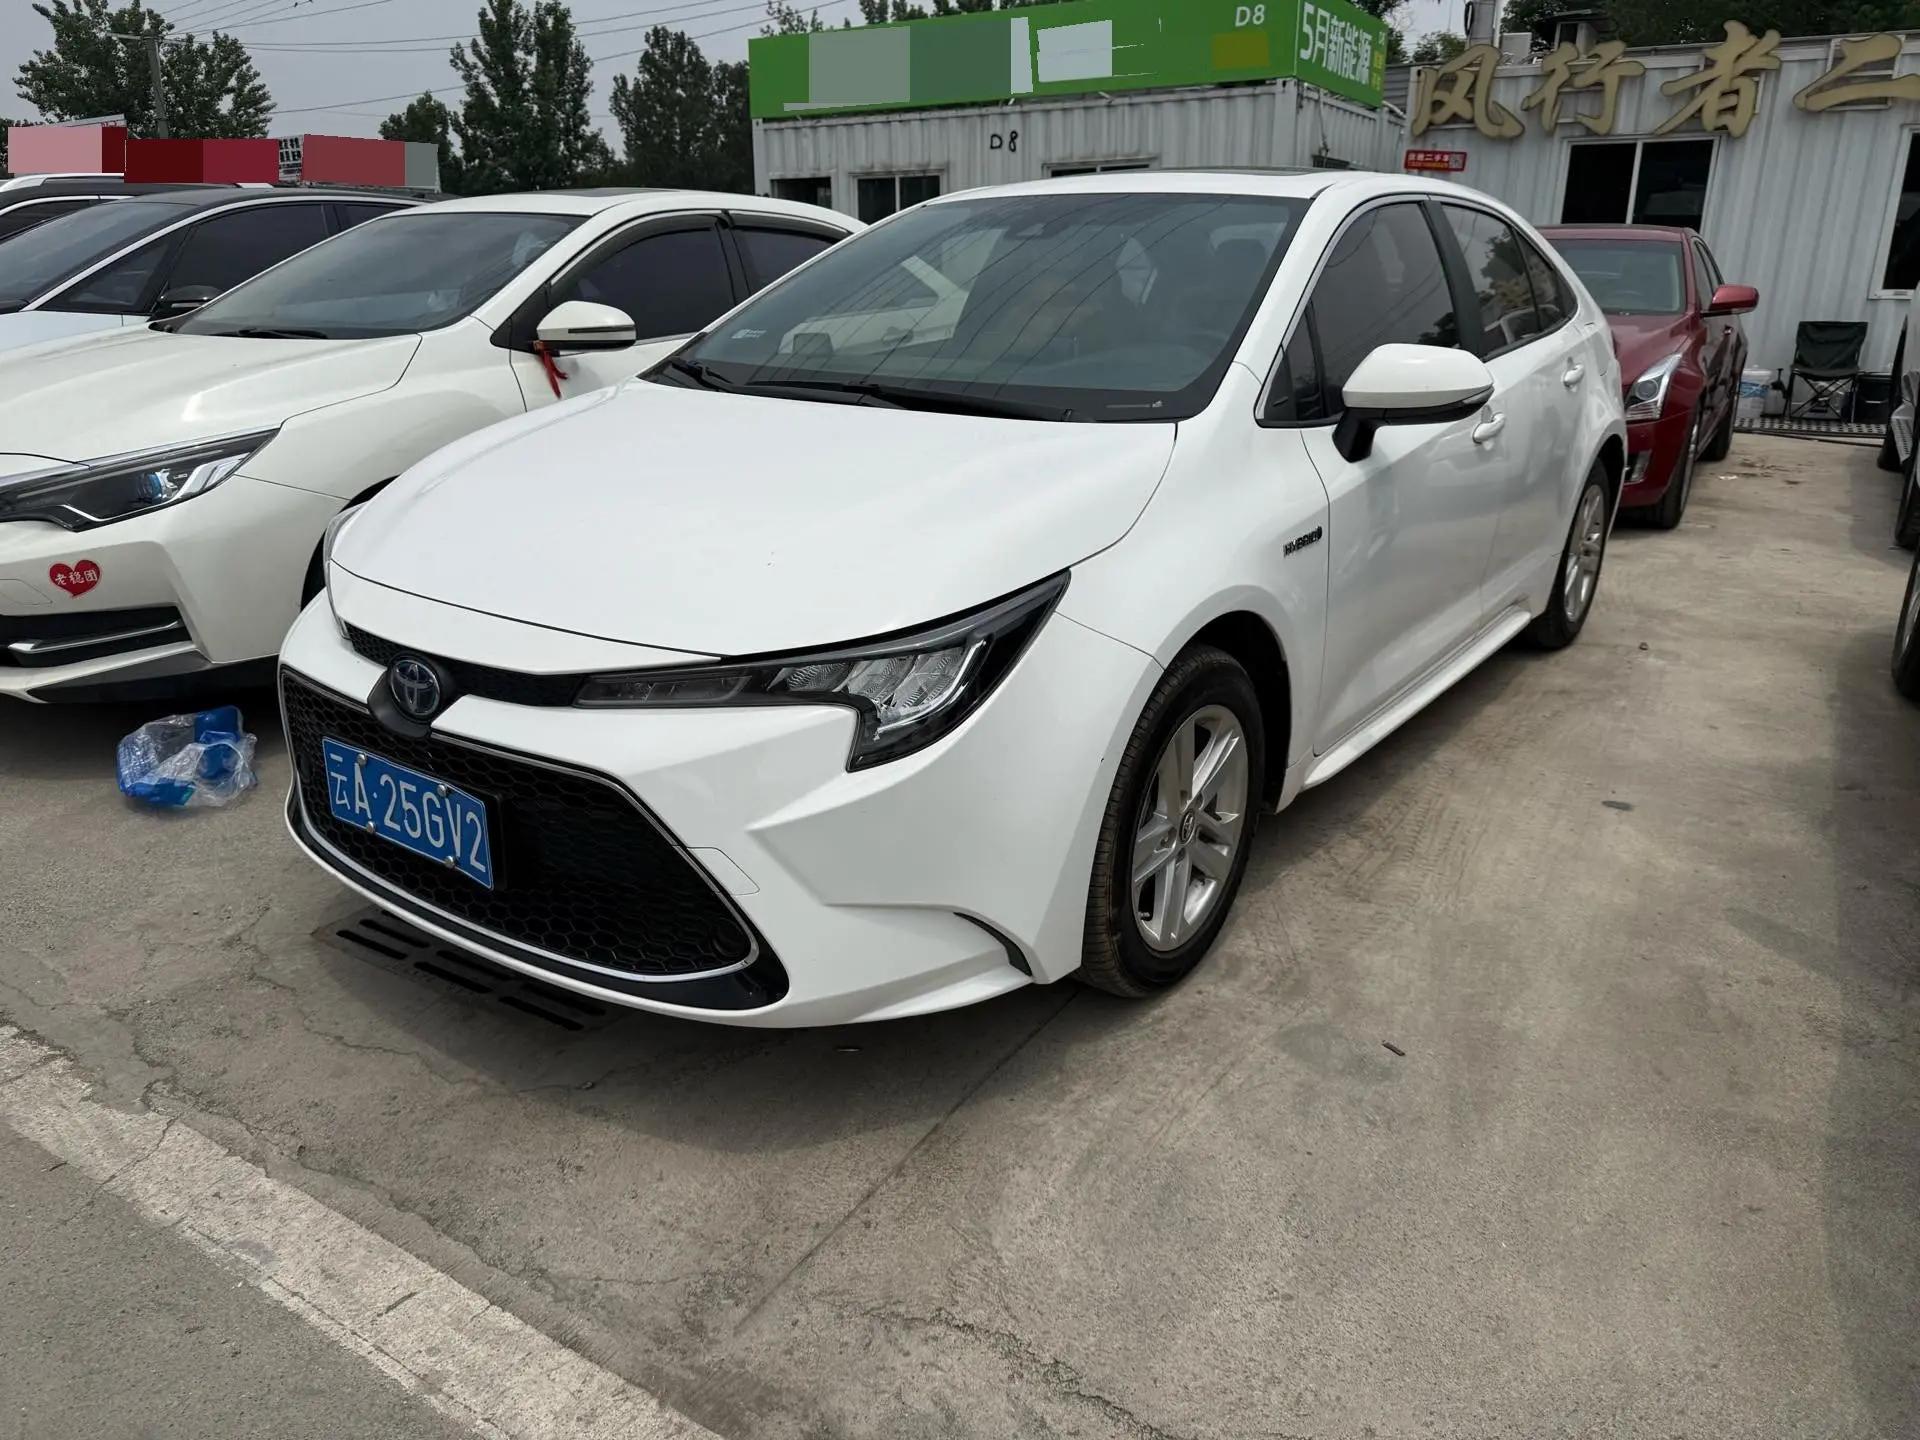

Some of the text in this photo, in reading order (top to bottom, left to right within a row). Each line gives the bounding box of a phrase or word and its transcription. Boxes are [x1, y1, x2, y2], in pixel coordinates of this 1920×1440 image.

[1235, 4, 1265, 27] D8
[1300, 2, 1372, 85] 5月新能源
